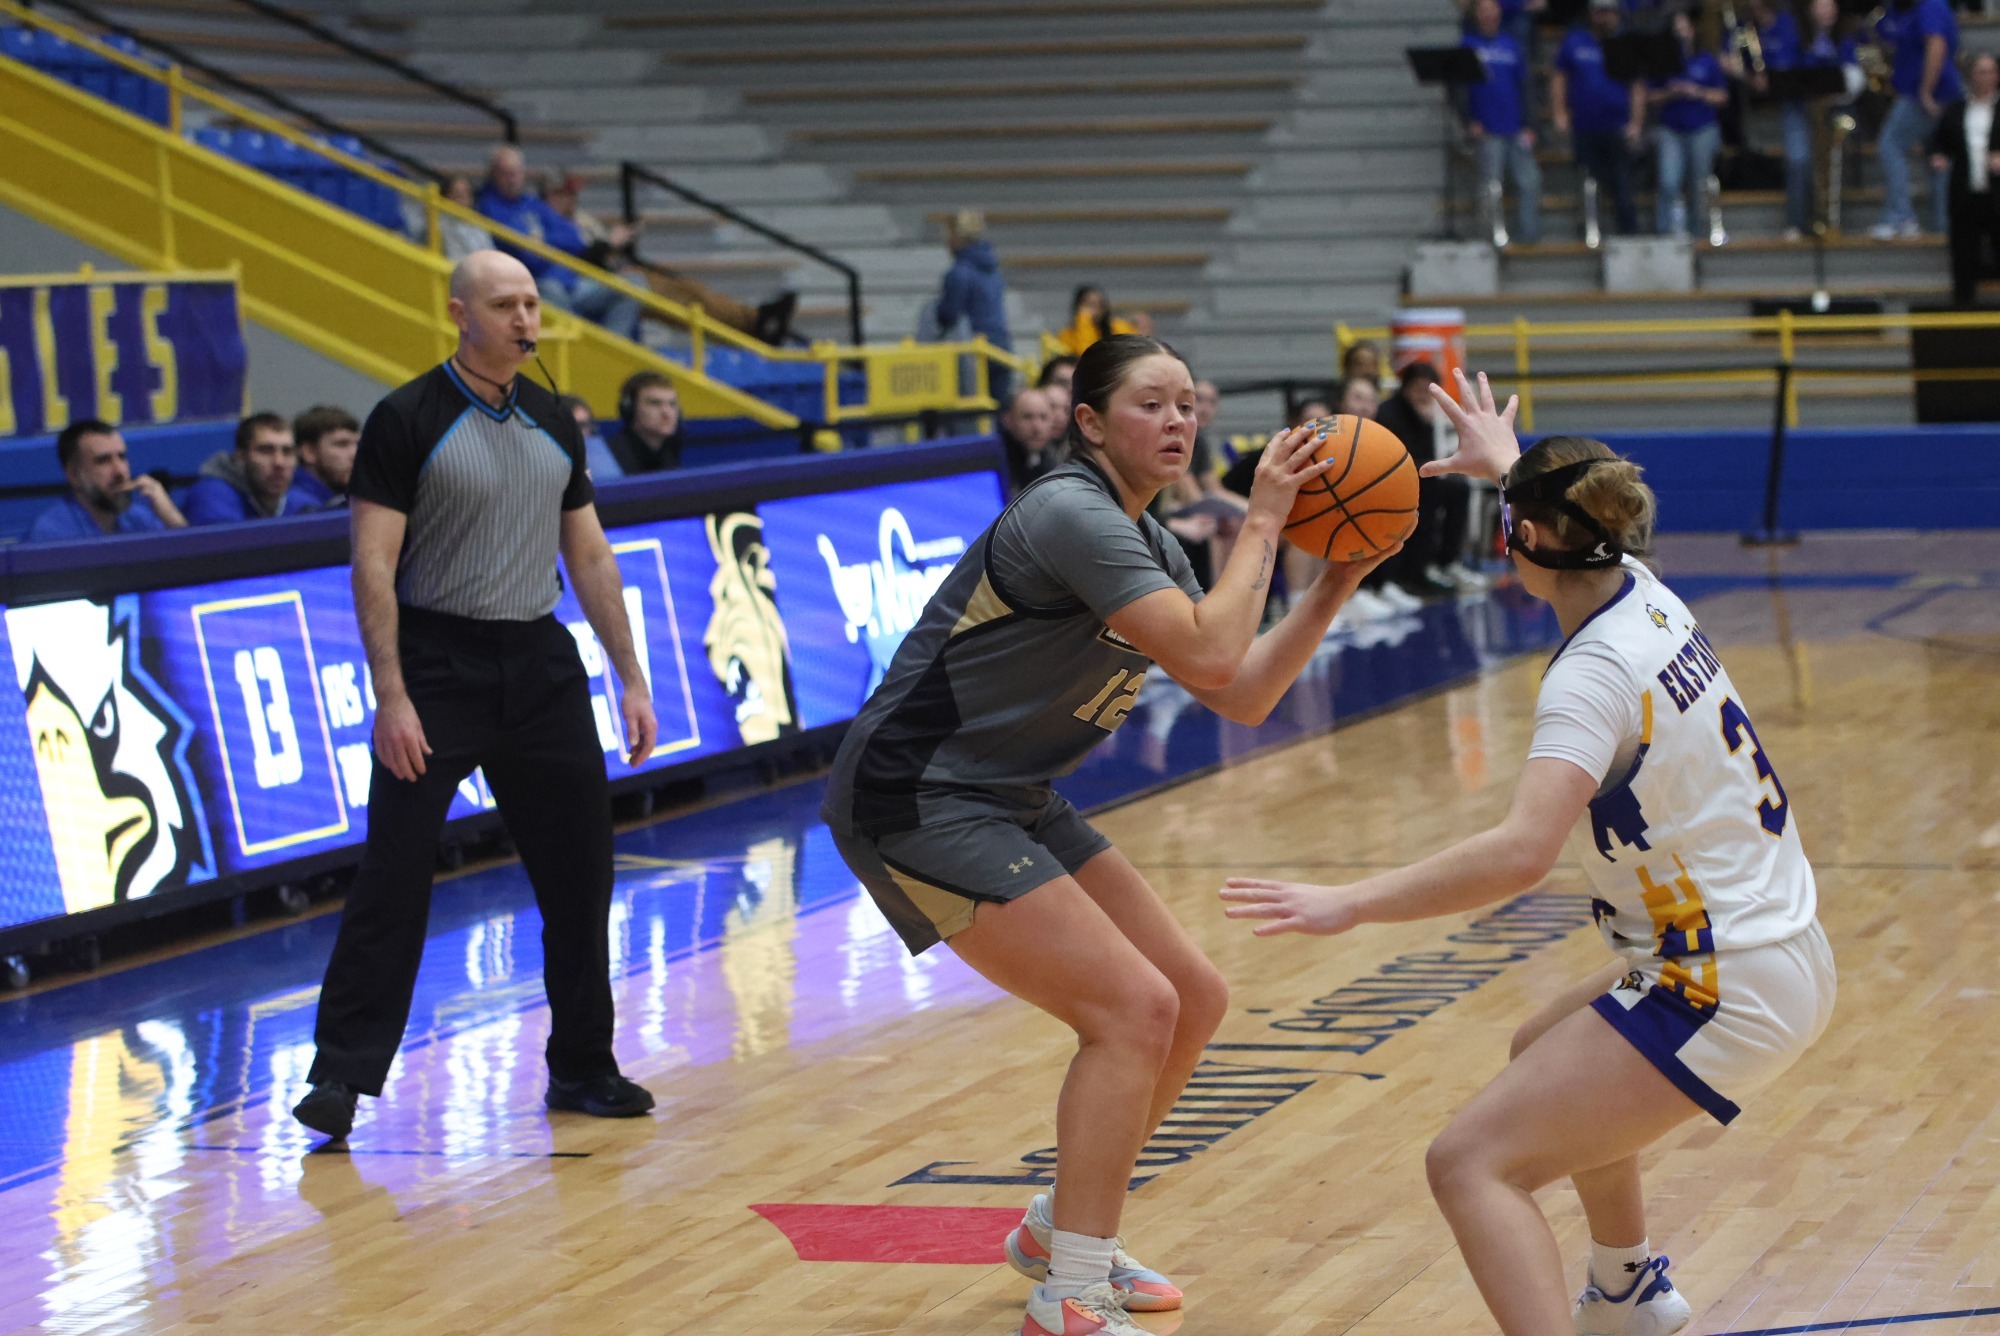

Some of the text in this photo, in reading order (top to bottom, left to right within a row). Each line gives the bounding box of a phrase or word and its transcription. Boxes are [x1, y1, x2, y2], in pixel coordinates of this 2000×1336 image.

[234, 646, 303, 789] 13
[1072, 668, 1146, 733] 12
[1718, 693, 1789, 840] 3
